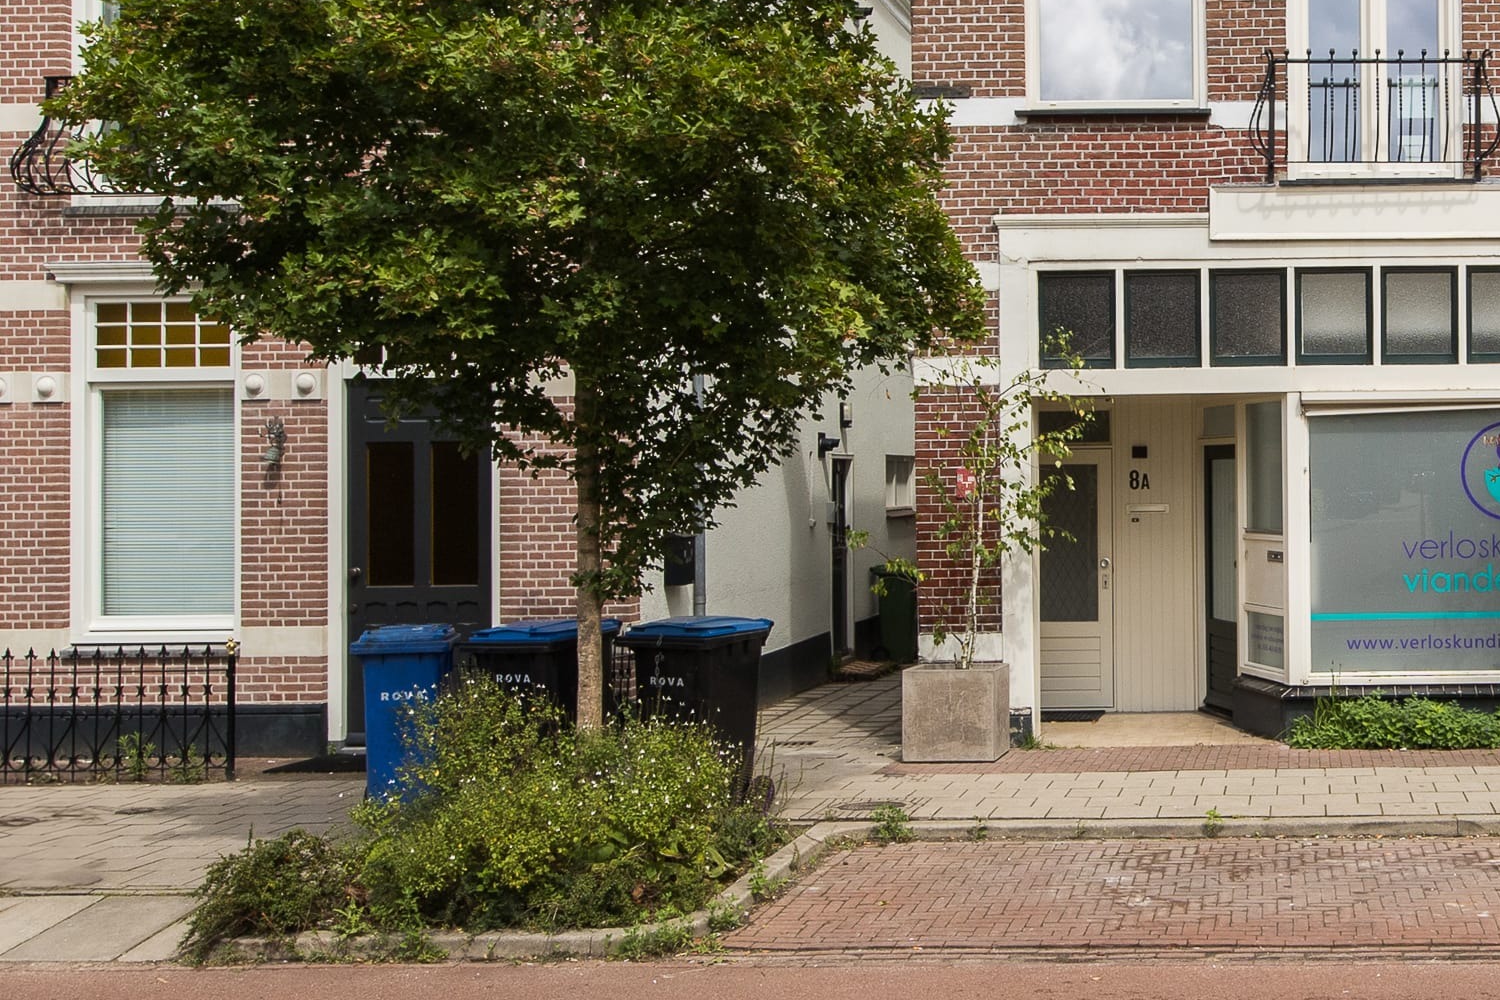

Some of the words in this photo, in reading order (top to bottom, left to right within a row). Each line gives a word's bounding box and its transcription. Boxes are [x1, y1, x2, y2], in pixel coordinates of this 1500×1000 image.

[1129, 469, 1150, 490] 8A
[496, 673, 531, 684] ROVA
[649, 676, 685, 687] ROVA
[380, 690, 424, 701] ROVA
